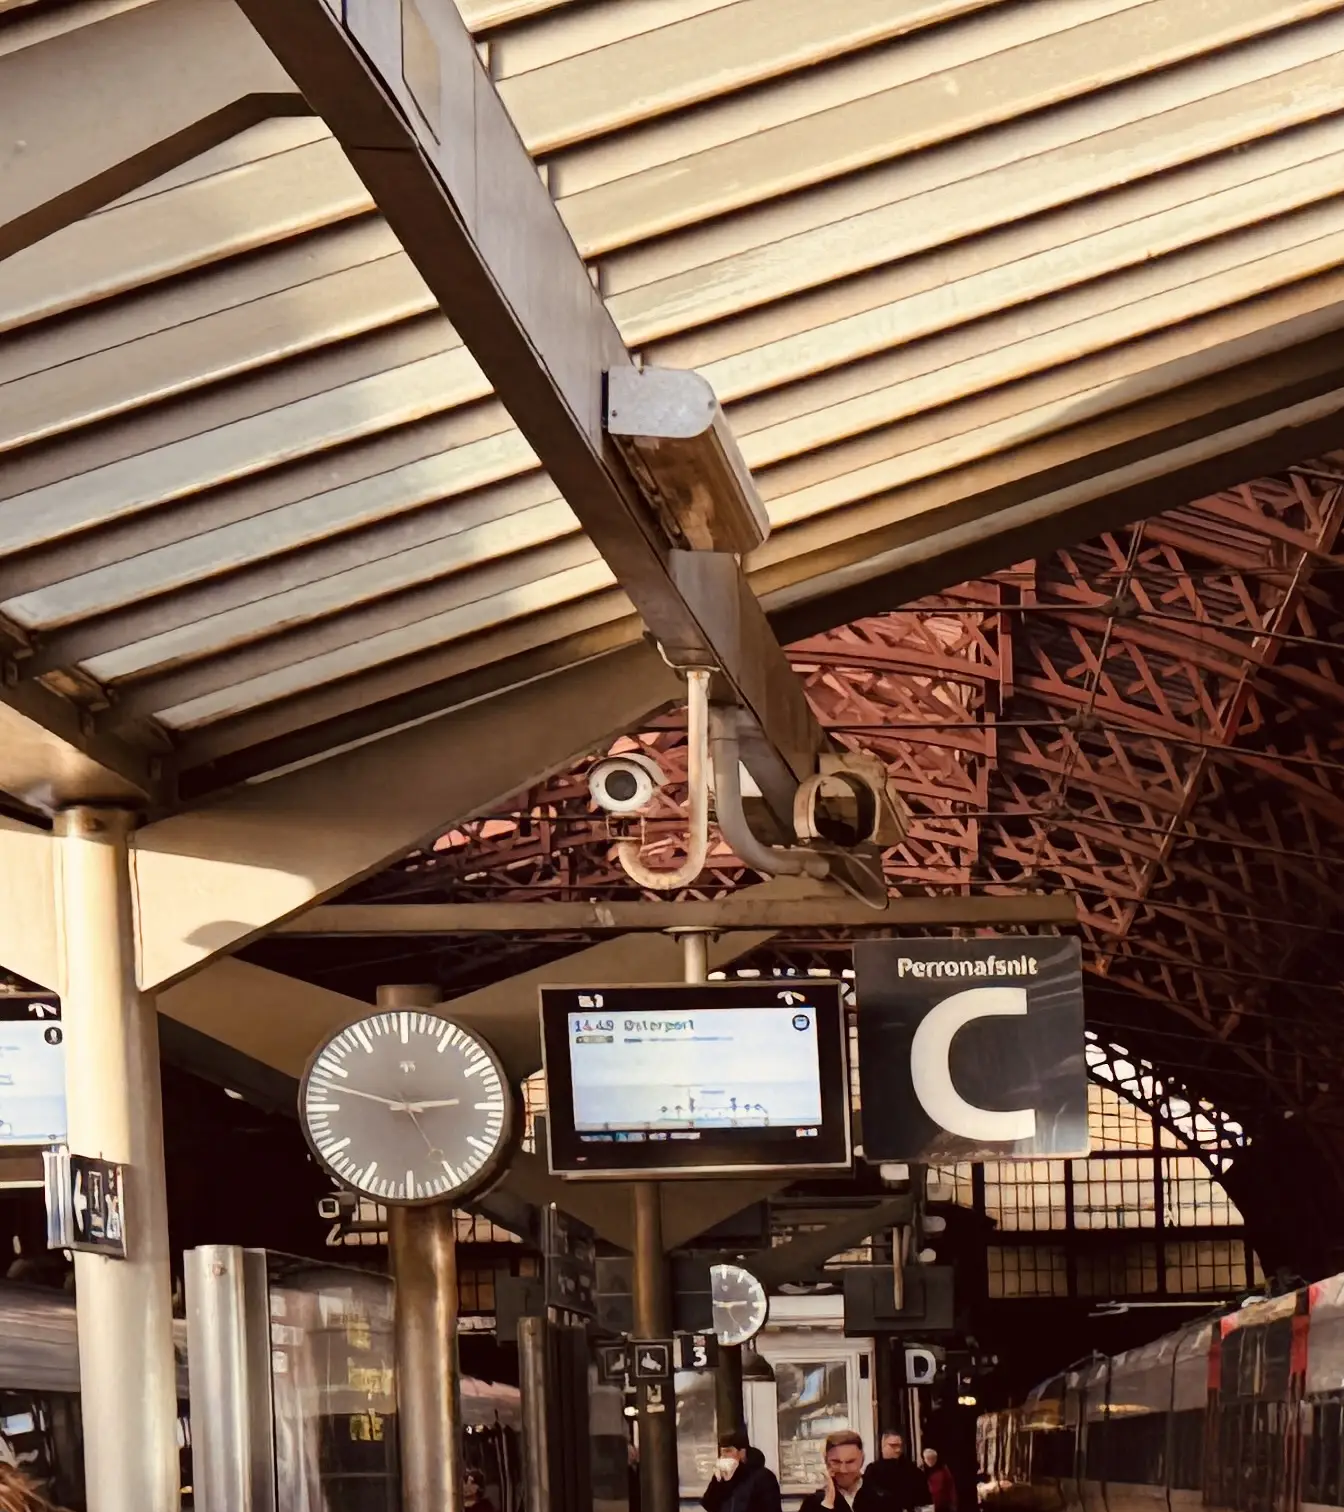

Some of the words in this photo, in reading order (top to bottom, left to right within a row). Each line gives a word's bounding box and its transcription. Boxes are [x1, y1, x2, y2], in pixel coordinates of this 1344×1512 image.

[897, 955, 1038, 978] Perronafsnit
[910, 986, 1037, 1141] C
[905, 1349, 937, 1384] D
